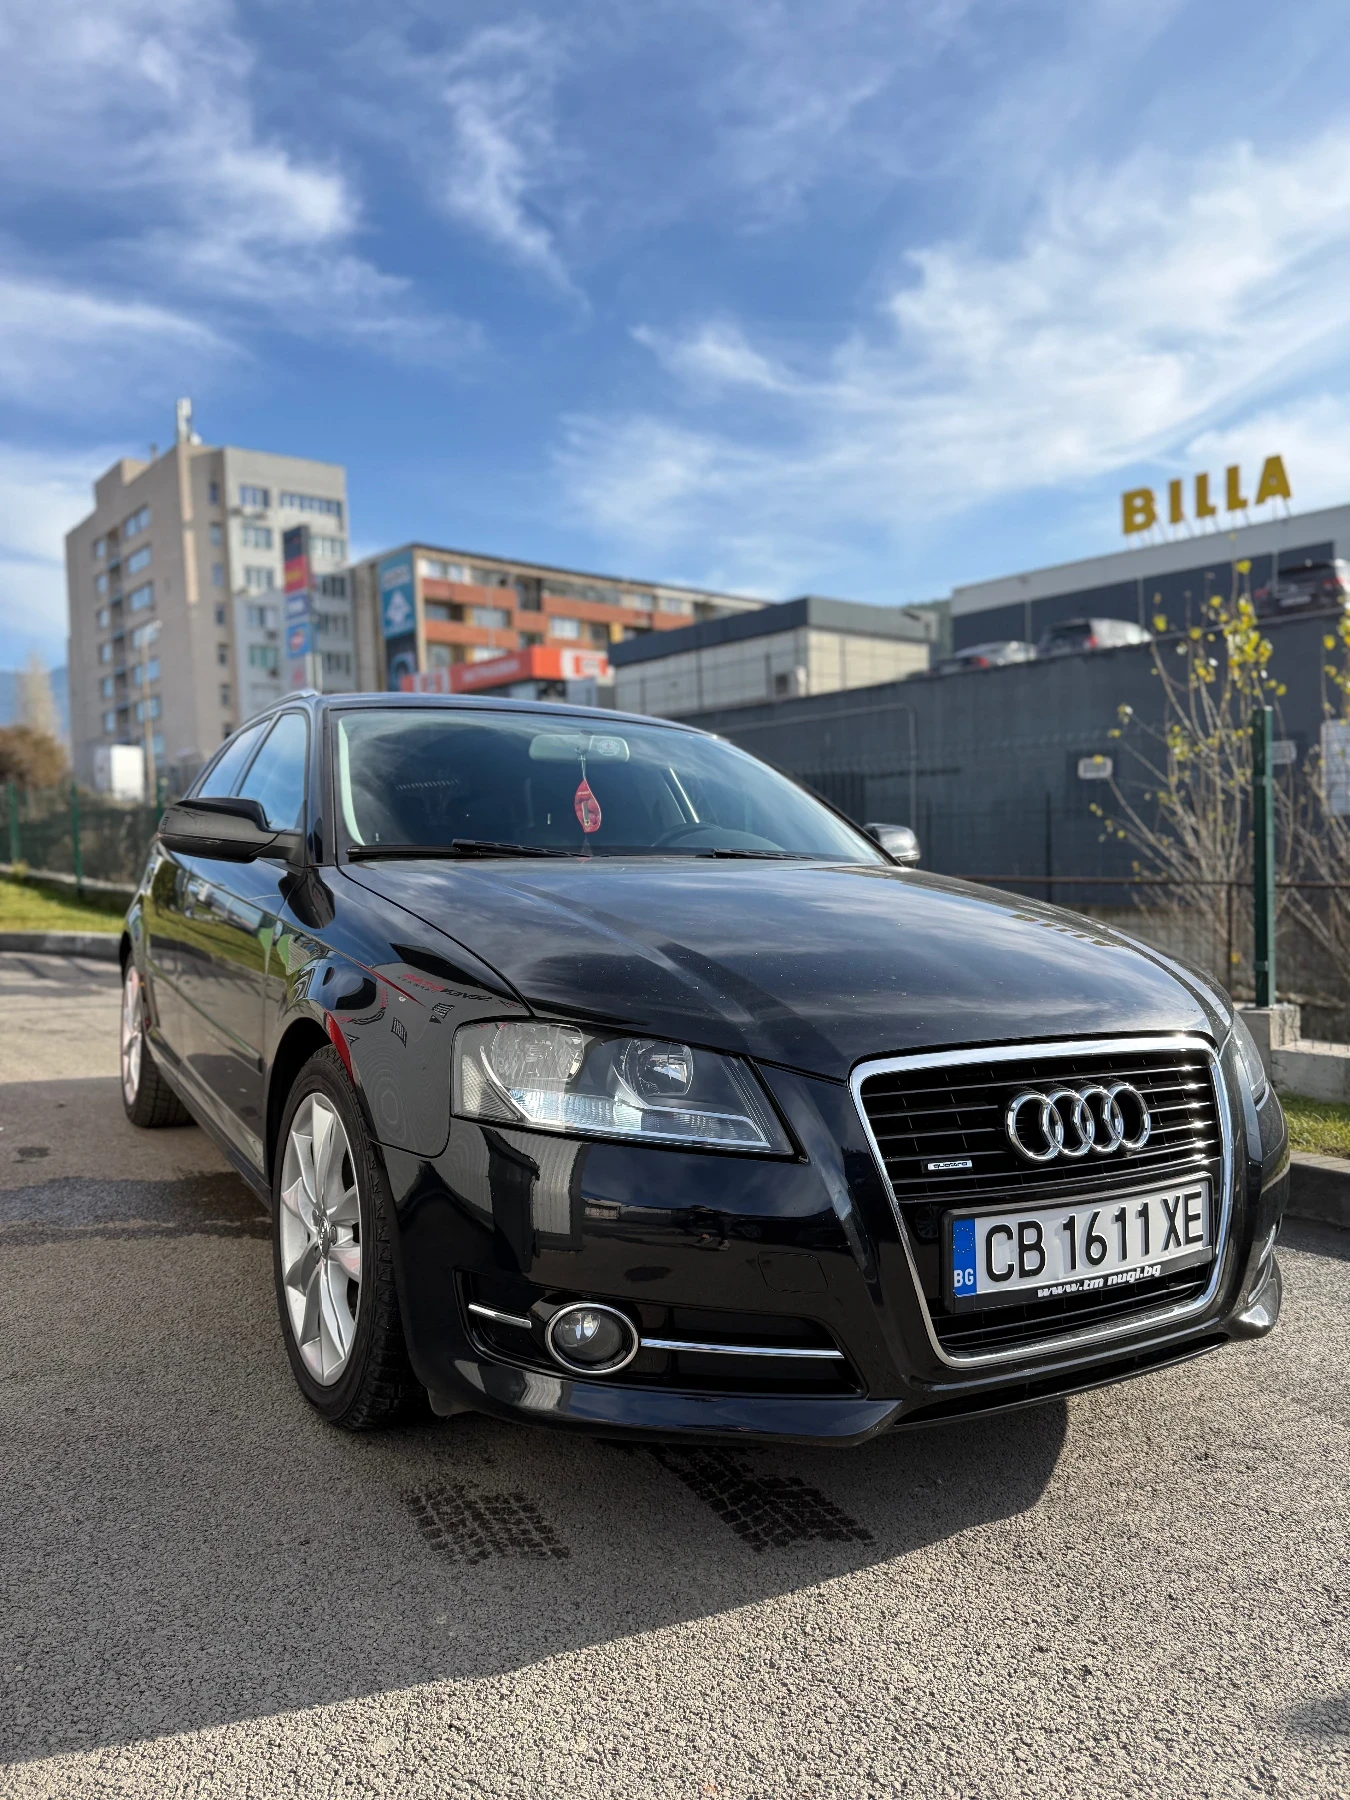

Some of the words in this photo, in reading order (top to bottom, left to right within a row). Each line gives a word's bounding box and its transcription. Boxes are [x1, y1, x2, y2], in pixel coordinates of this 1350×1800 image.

[1122, 455, 1291, 534] BILLA
[985, 1220, 1047, 1282] CB
[1061, 1201, 1151, 1271] 1611
[1160, 1190, 1204, 1250] XE
[953, 1268, 974, 1288] BG
